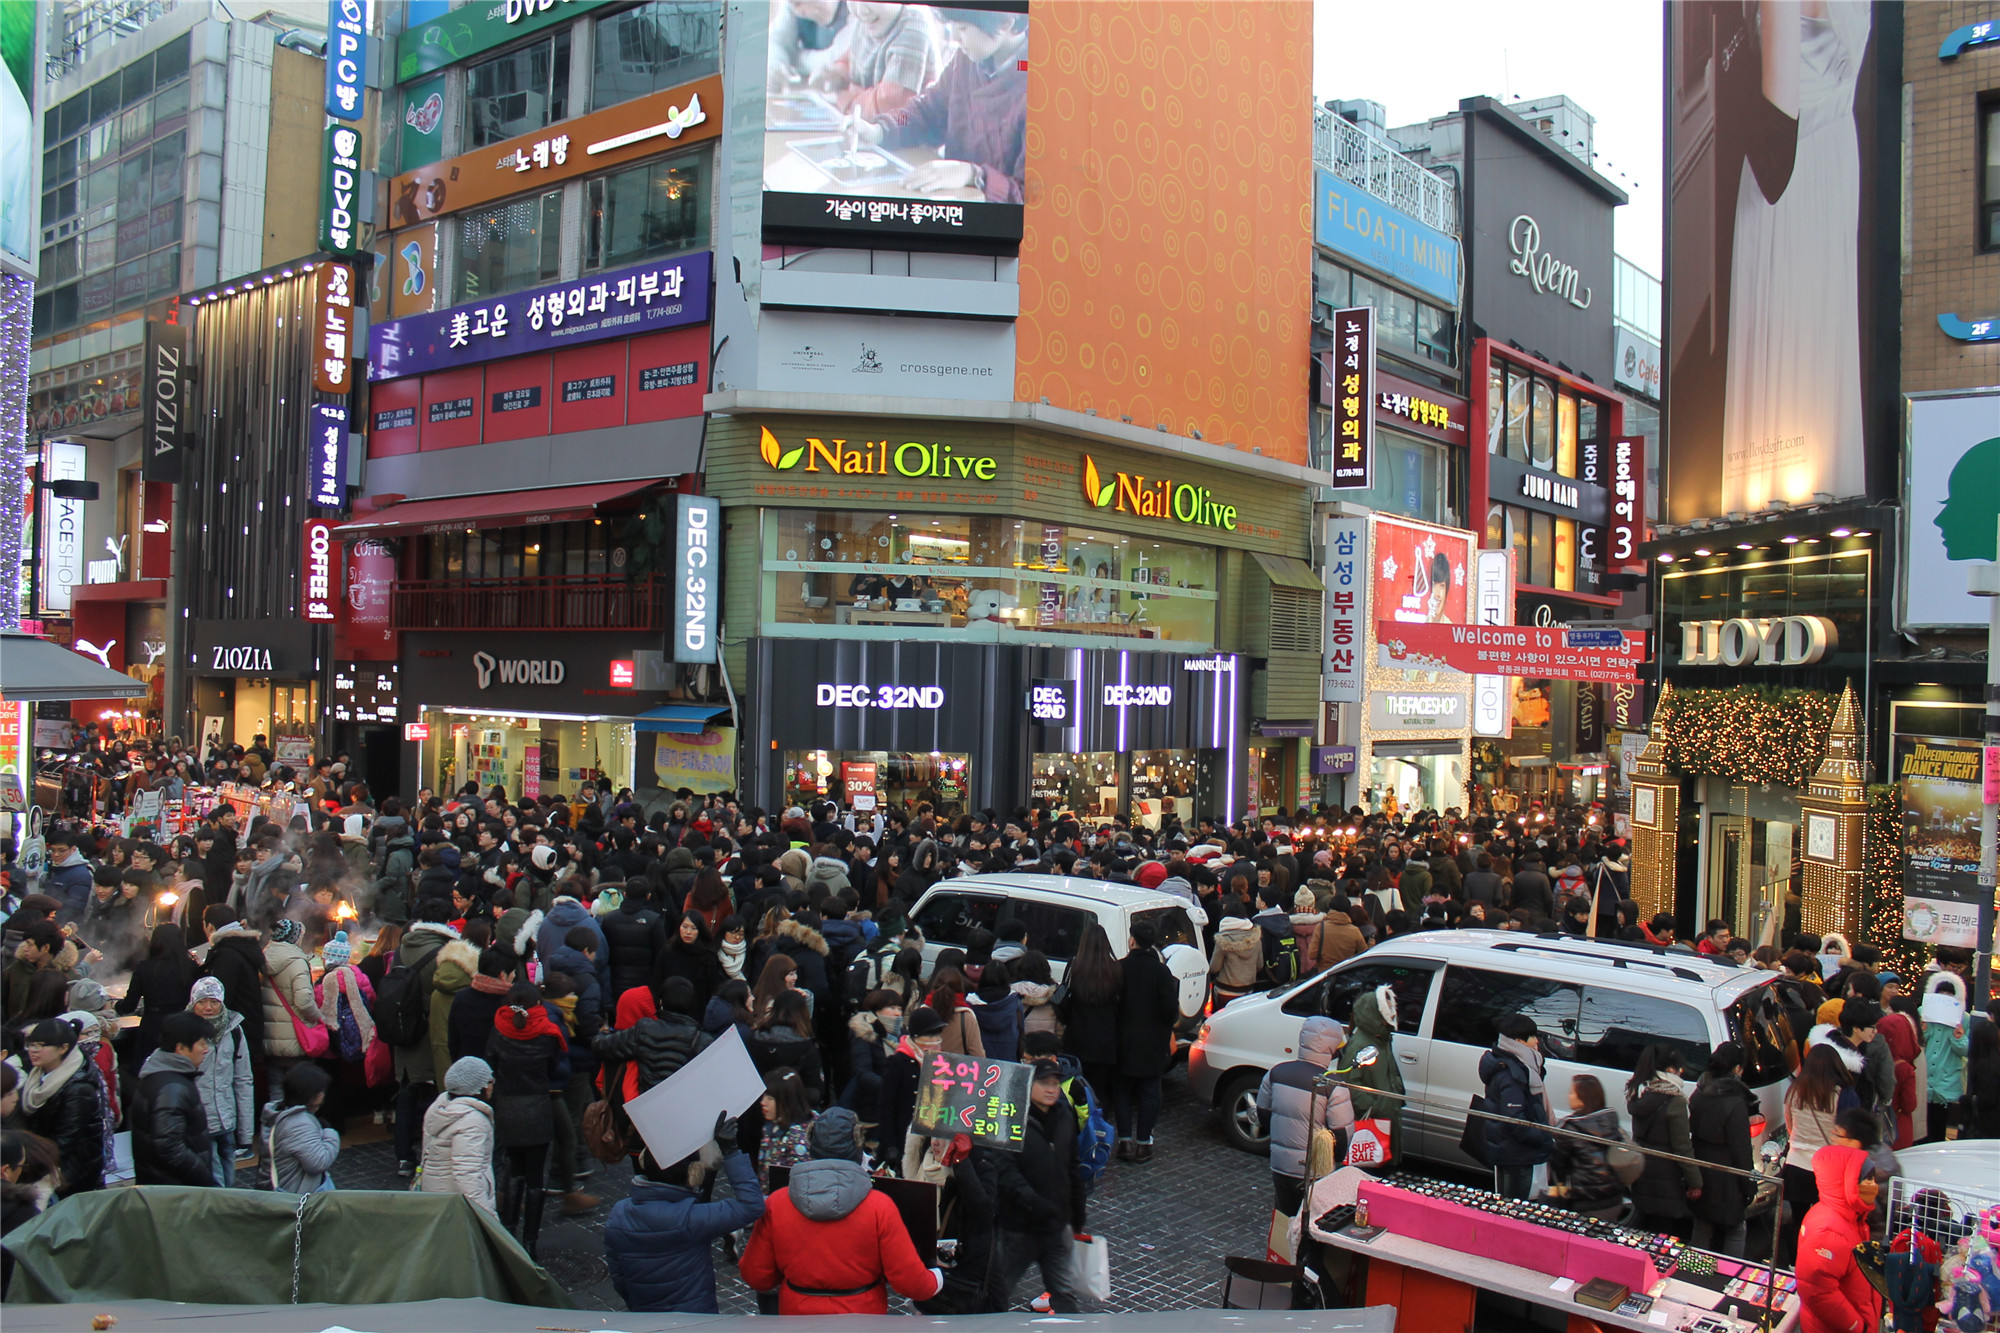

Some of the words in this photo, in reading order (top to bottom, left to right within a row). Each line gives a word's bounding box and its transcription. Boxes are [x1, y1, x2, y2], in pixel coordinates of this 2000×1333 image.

[1971, 24, 1991, 38] 3F
[514, 134, 570, 173] 노래방
[825, 199, 866, 221] 기술이
[868, 201, 909, 223] 얼마나
[910, 203, 963, 227] 좋아지면
[1413, 234, 1453, 280] MINI
[1508, 214, 1592, 310] Roem
[449, 303, 509, 349] 美고운
[526, 265, 685, 331] 성형외과·피부과
[1971, 322, 1992, 336] 2F
[325, 308, 347, 385] 노래방
[900, 362, 993, 377] crossgene.net
[154, 343, 181, 457] ZIOZIA
[804, 437, 889, 475] Nail
[893, 442, 997, 481] Olive
[1727, 435, 1805, 463] www.lloydgift.com
[837, 488, 888, 501] ネイルアート
[1522, 473, 1551, 502] JUNO
[1553, 482, 1578, 509] HAIR
[1614, 442, 1636, 522] 준오헤어
[1115, 472, 1172, 519] Nail
[1174, 483, 1237, 531] Olive
[1613, 526, 1633, 559] 3
[88, 559, 117, 585] PUMA
[309, 524, 330, 599] COFFEE
[685, 507, 709, 651] DEC.32ND
[1452, 626, 1527, 647] Welcome
[1535, 630, 1552, 648] to
[1678, 615, 1832, 667] LLOYD
[212, 646, 273, 671] ZIOZIA
[1184, 659, 1233, 672] MANNEQUIN
[1477, 650, 1511, 662] 불편한
[1515, 652, 1550, 664] 사항이
[1554, 654, 1601, 667] 있으시면
[1497, 665, 1569, 677] 명동관광특구협의회
[1573, 669, 1588, 678] TEL
[499, 659, 565, 685] WORLD
[1327, 679, 1355, 689] 773-6622
[816, 683, 944, 709] DEC.32ND
[1032, 686, 1066, 703] DEC.
[1103, 685, 1172, 707] DEC.32ND
[1386, 695, 1458, 715] THEFACESHOP
[1032, 703, 1066, 719] 32ND
[1901, 753, 1943, 776] DANCE
[1941, 762, 1980, 780] NIGHT
[7, 788, 23, 803] 50
[847, 781, 874, 792] 30%
[1980, 876, 1989, 884] 19
[1351, 1141, 1377, 1154] SUPER
[1351, 1152, 1375, 1163] SALE
